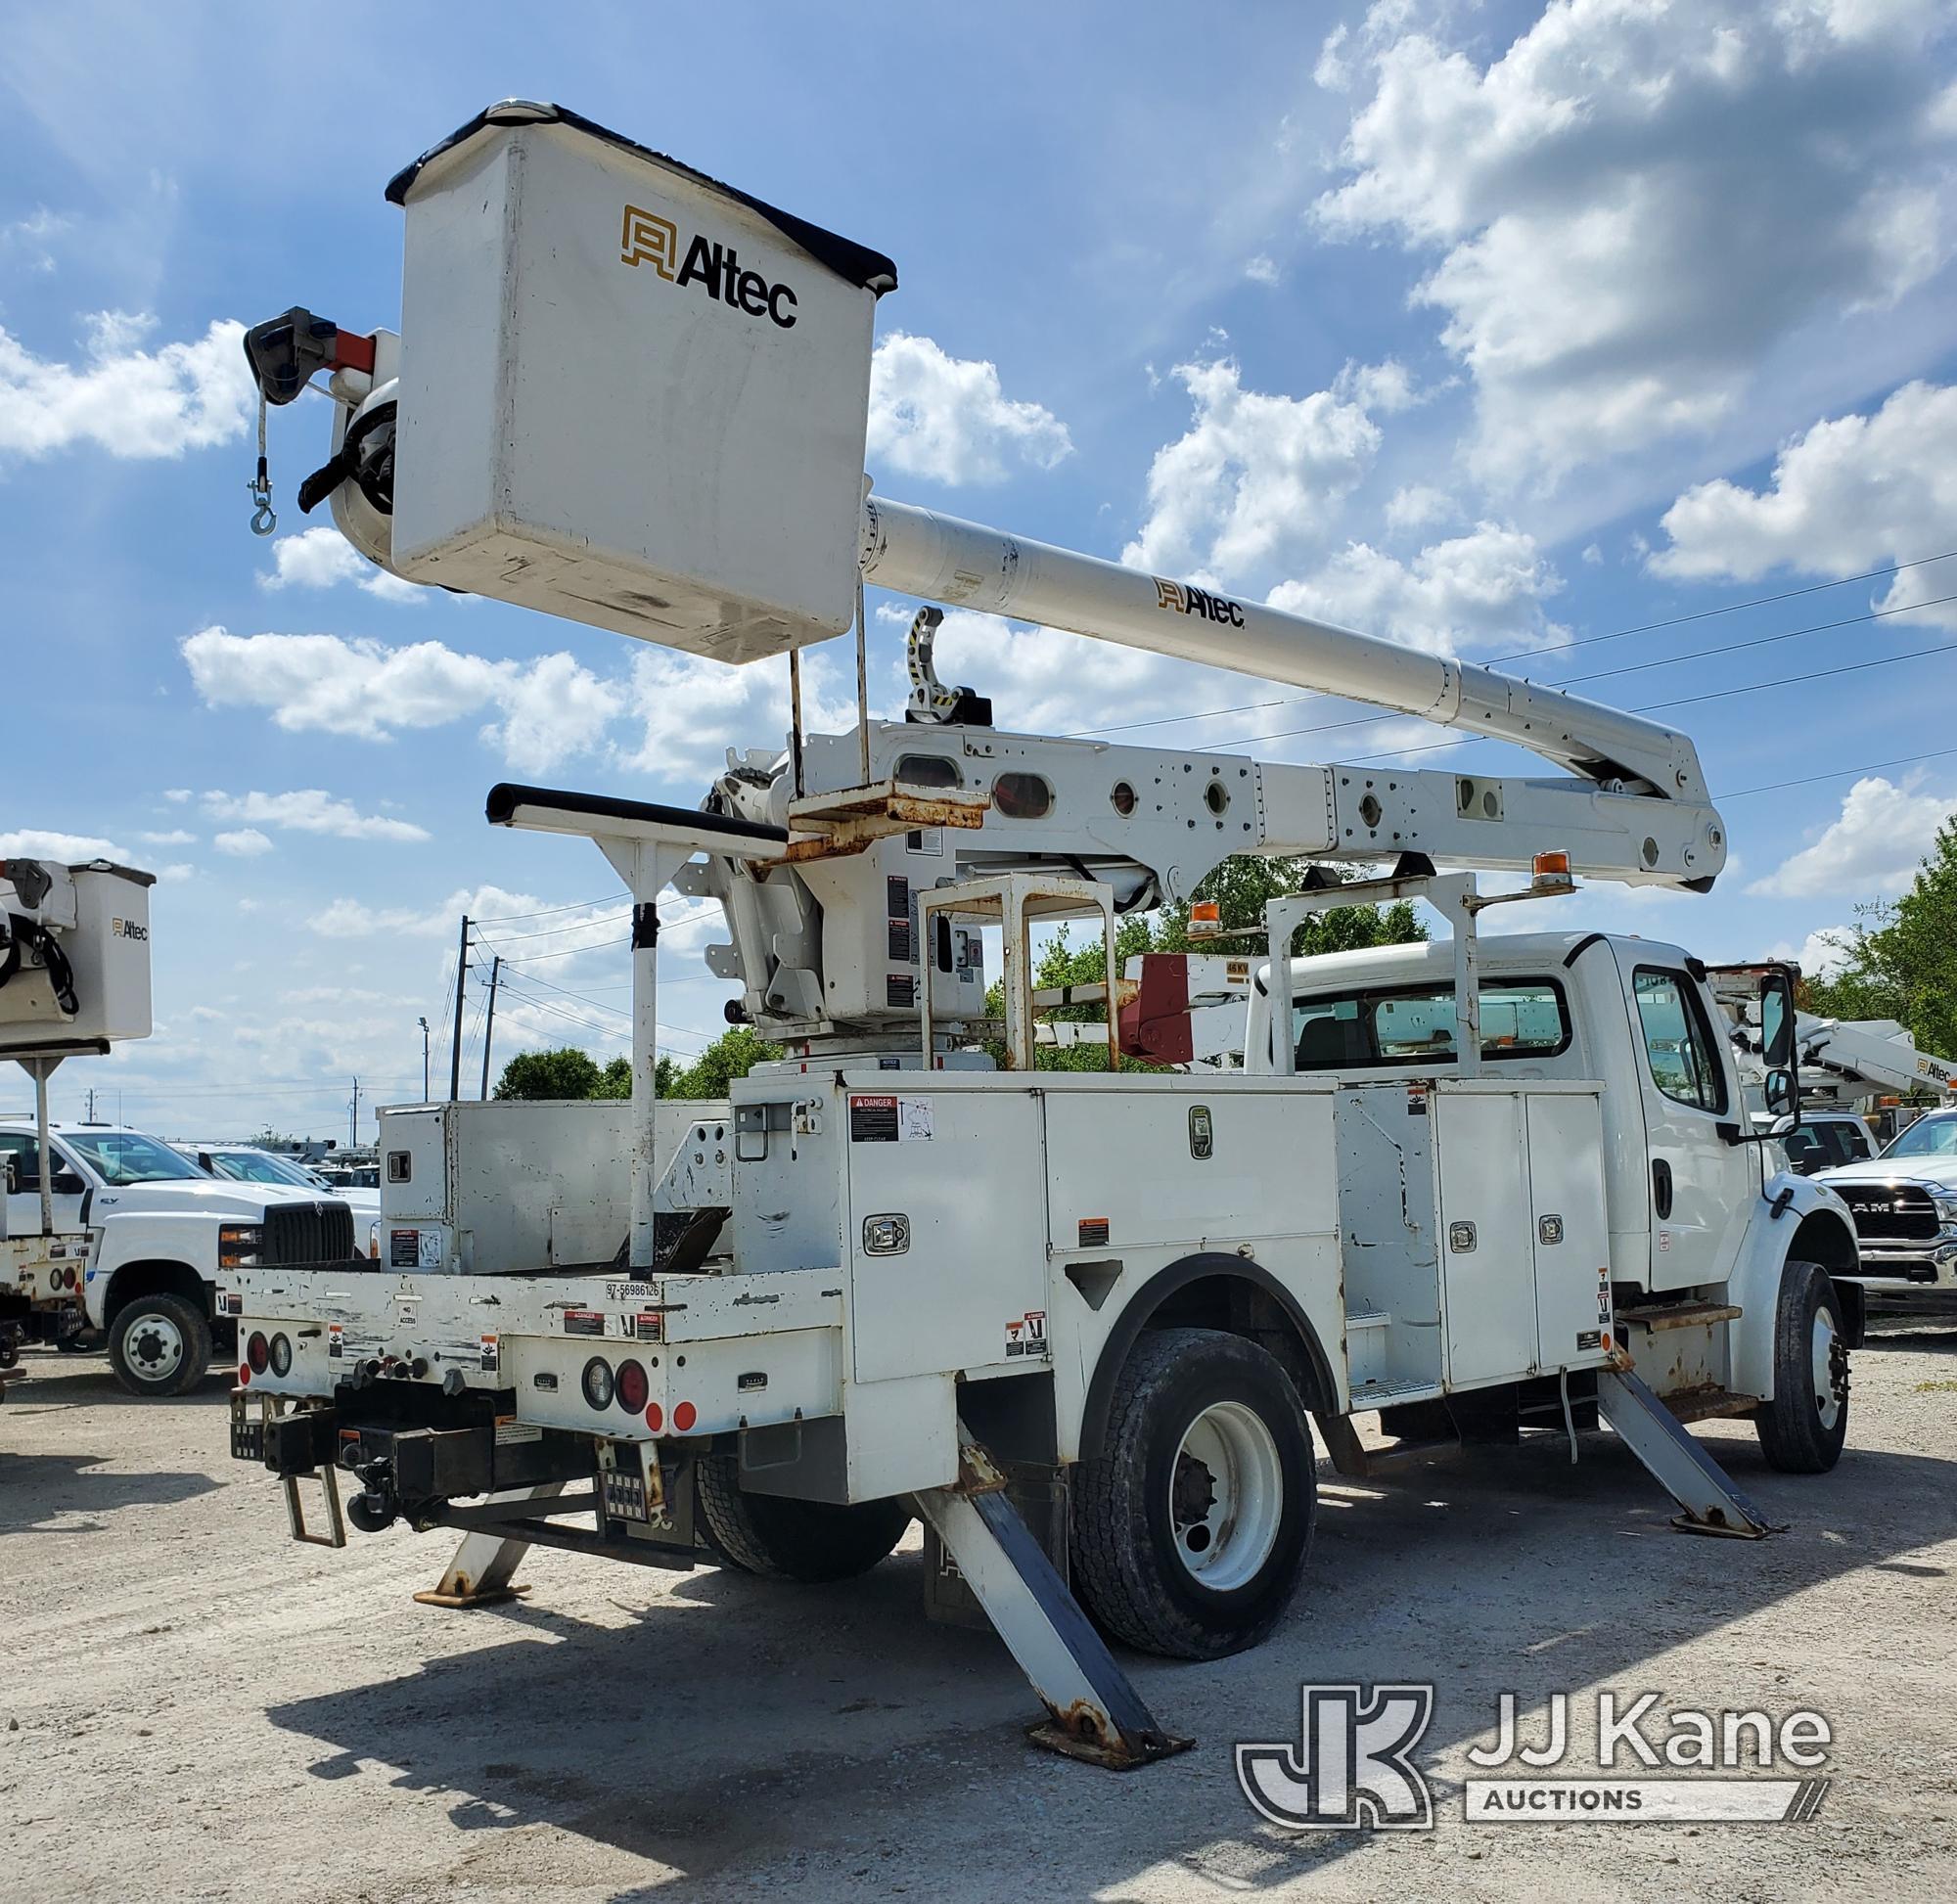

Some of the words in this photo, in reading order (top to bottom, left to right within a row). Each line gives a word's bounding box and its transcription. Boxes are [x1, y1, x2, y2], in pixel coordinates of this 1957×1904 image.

[676, 234, 798, 329] Altec
[1185, 585, 1245, 628] Altec
[124, 920, 148, 941] Altec
[1928, 1062, 1950, 1083] Altec
[864, 1098, 892, 1107] DANGER
[1852, 1203, 1889, 1212] AM
